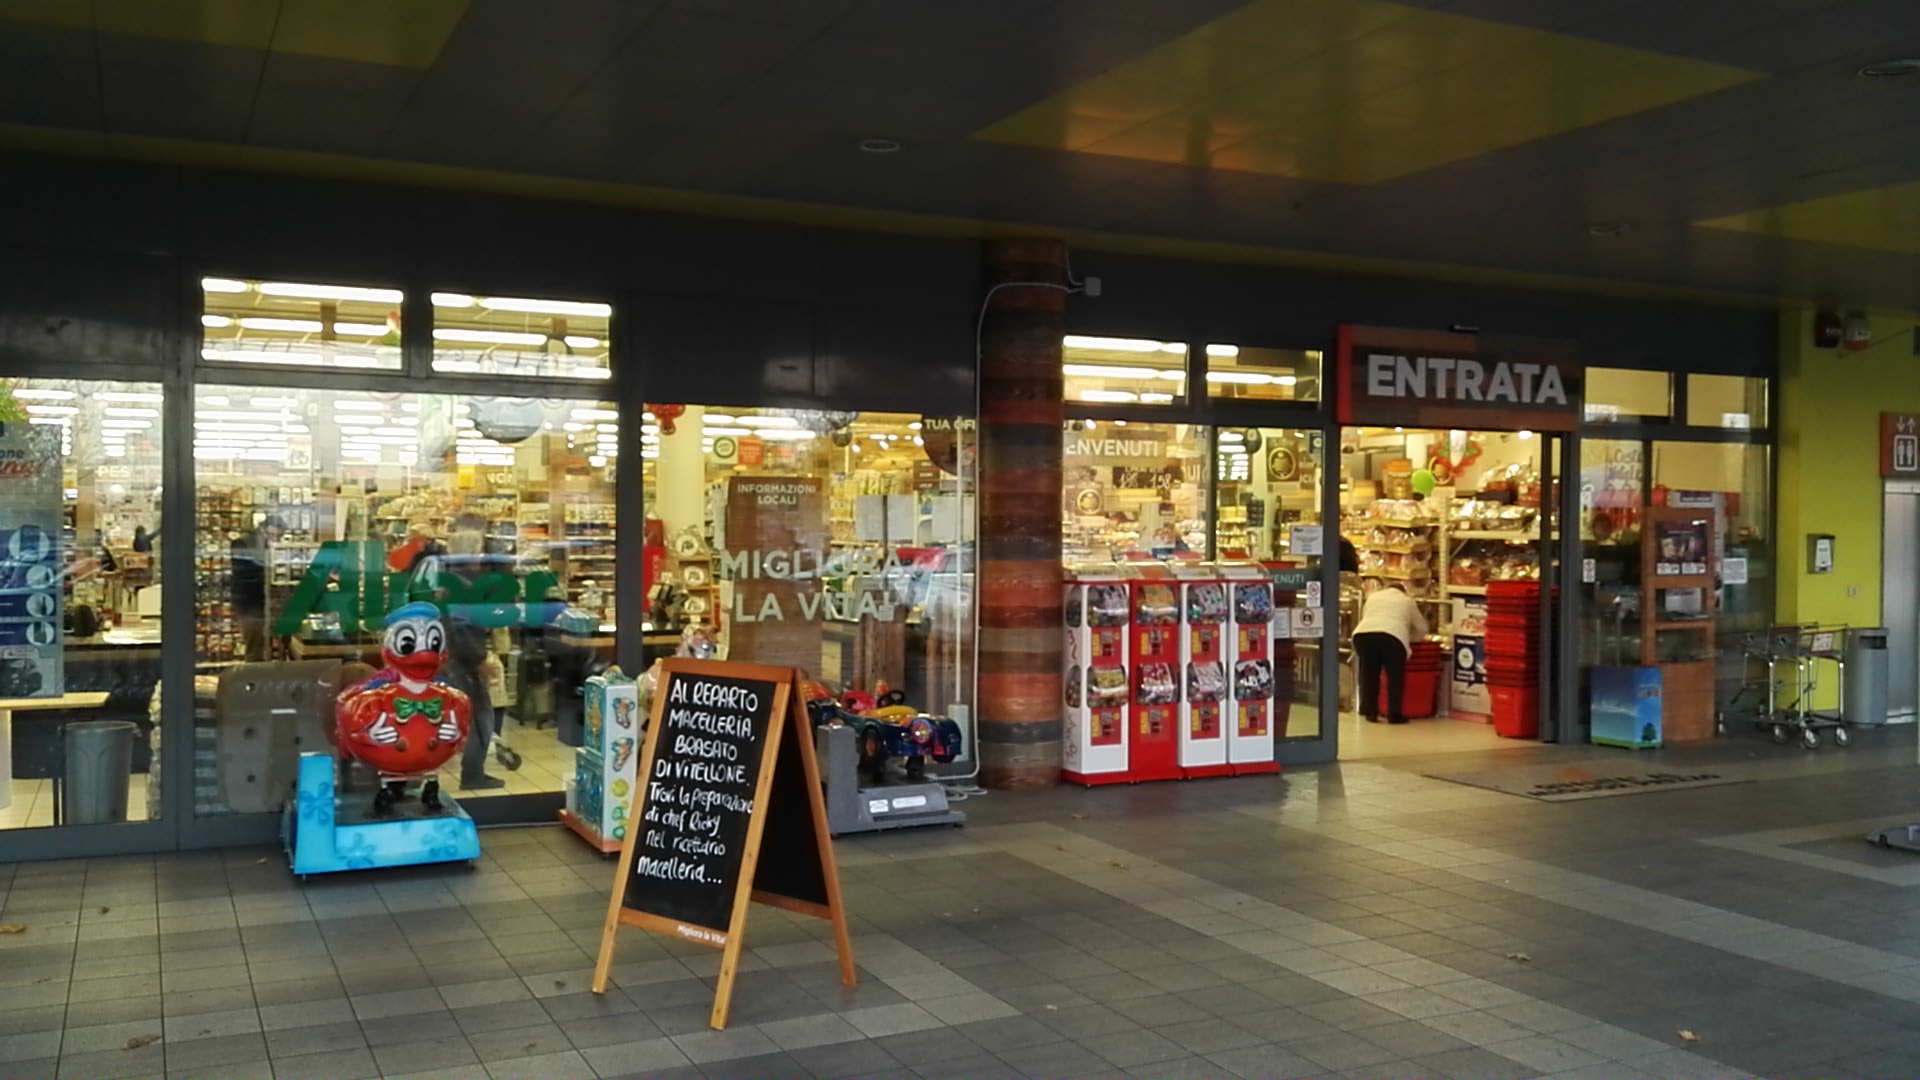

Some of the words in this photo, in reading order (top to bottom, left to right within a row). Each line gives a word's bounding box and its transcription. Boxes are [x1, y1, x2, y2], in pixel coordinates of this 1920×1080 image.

[1367, 353, 1567, 405] ENTRATA
[924, 418, 952, 431] TUA
[737, 484, 817, 494] INFORMAZIONI
[757, 495, 797, 505] LOCALI
[720, 549, 904, 579] MIGLIORA
[1268, 574, 1305, 584] ENUTI
[736, 592, 785, 622] LA
[693, 681, 759, 712] REPARTO
[674, 734, 738, 761] BRASATO
[679, 786, 690, 805] la
[645, 805, 659, 822] di
[662, 808, 688, 832] chef
